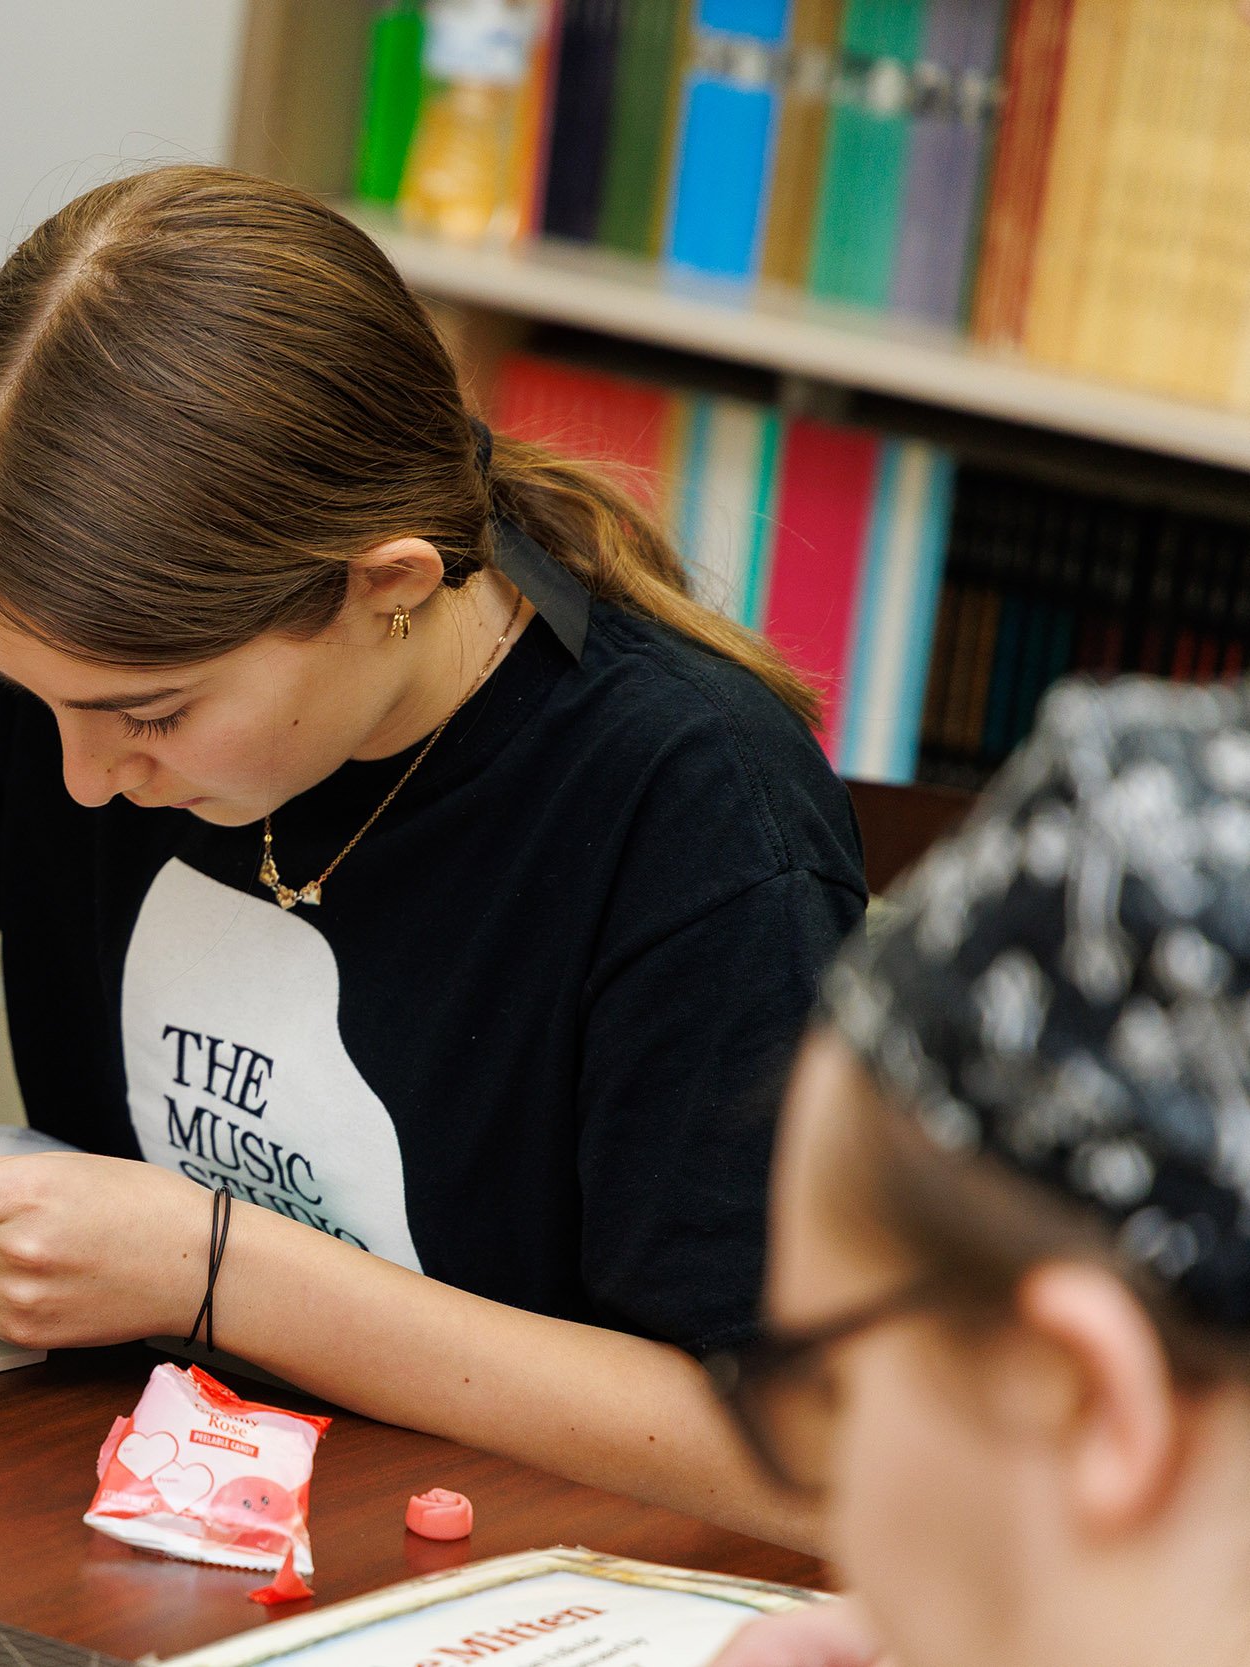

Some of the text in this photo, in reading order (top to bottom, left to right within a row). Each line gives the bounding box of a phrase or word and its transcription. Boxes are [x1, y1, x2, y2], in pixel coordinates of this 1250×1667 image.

[162, 1024, 274, 1119] THE
[163, 1094, 322, 1206] MUSIC
[209, 1412, 248, 1438] Rose
[434, 1605, 607, 1664] Mitten
